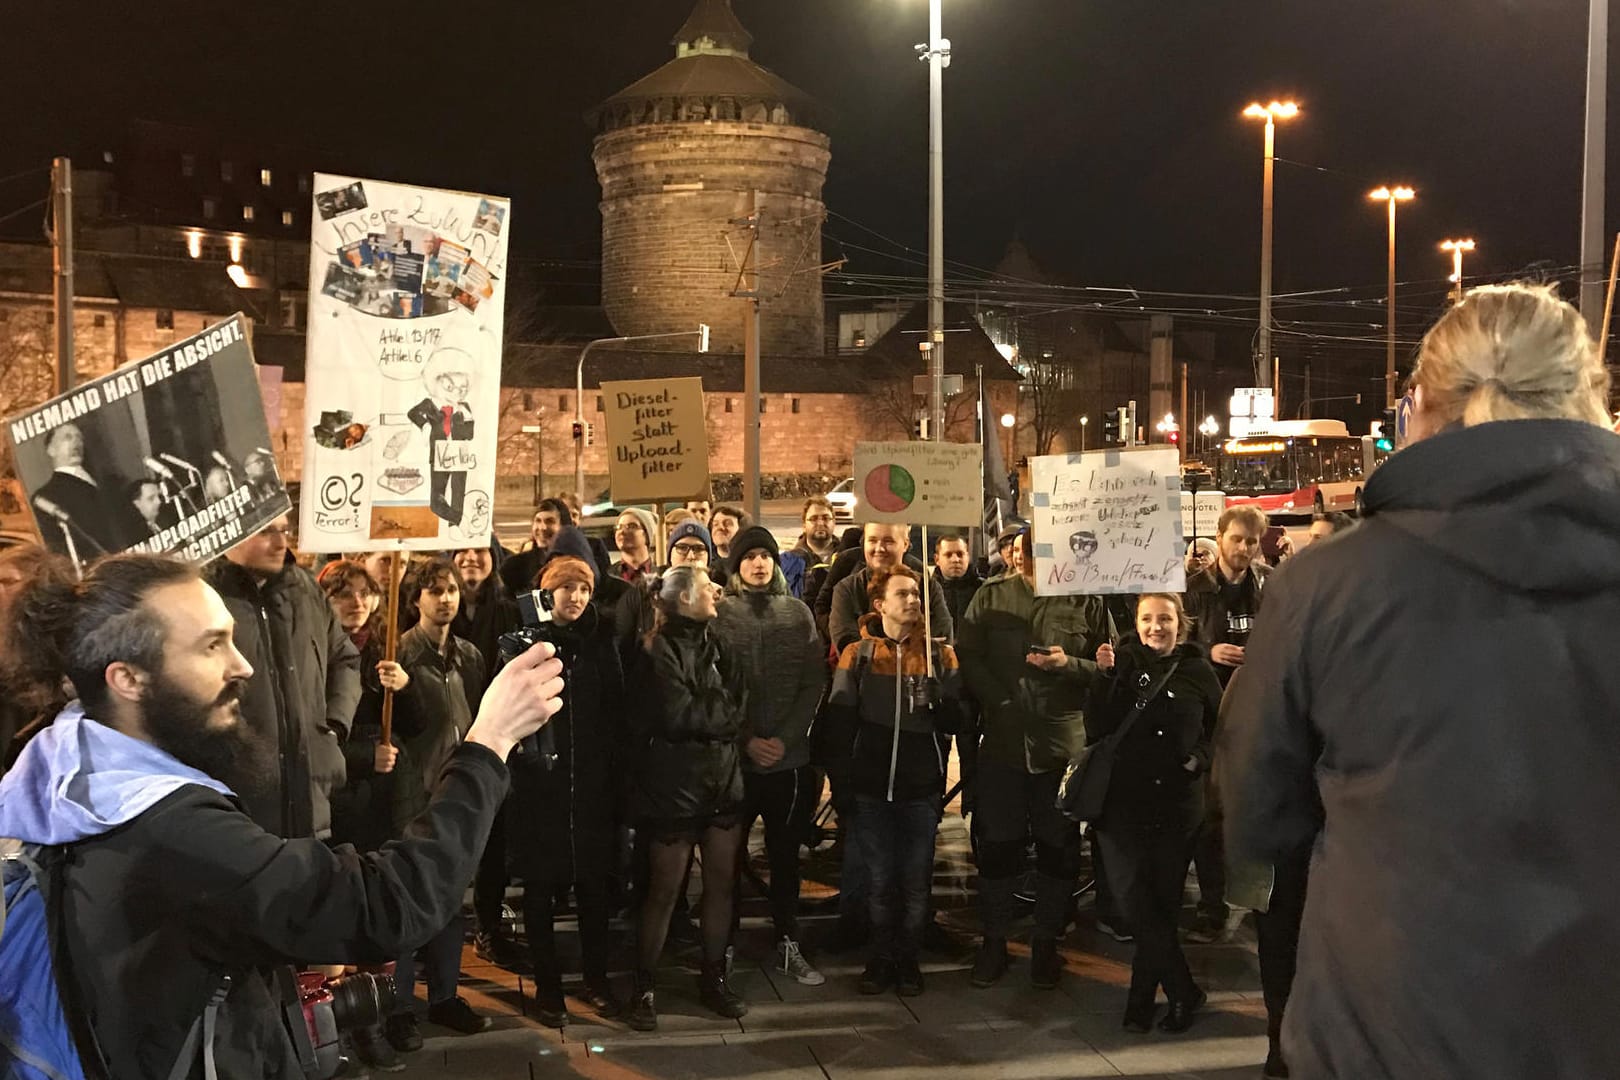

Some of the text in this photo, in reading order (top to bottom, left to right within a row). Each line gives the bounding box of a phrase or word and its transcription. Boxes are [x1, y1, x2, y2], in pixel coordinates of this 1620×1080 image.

[414, 349, 422, 363] 6
[11, 319, 244, 444] NIEMAND HAT DIE ABSICHT,
[617, 388, 678, 409] Diesel-
[636, 408, 674, 425] filter
[437, 443, 477, 470] Verlag
[617, 439, 692, 464] Upload-
[642, 461, 683, 480] filter
[149, 485, 251, 552] UPLOADFILTER
[1180, 504, 1218, 512] NOVOTEL
